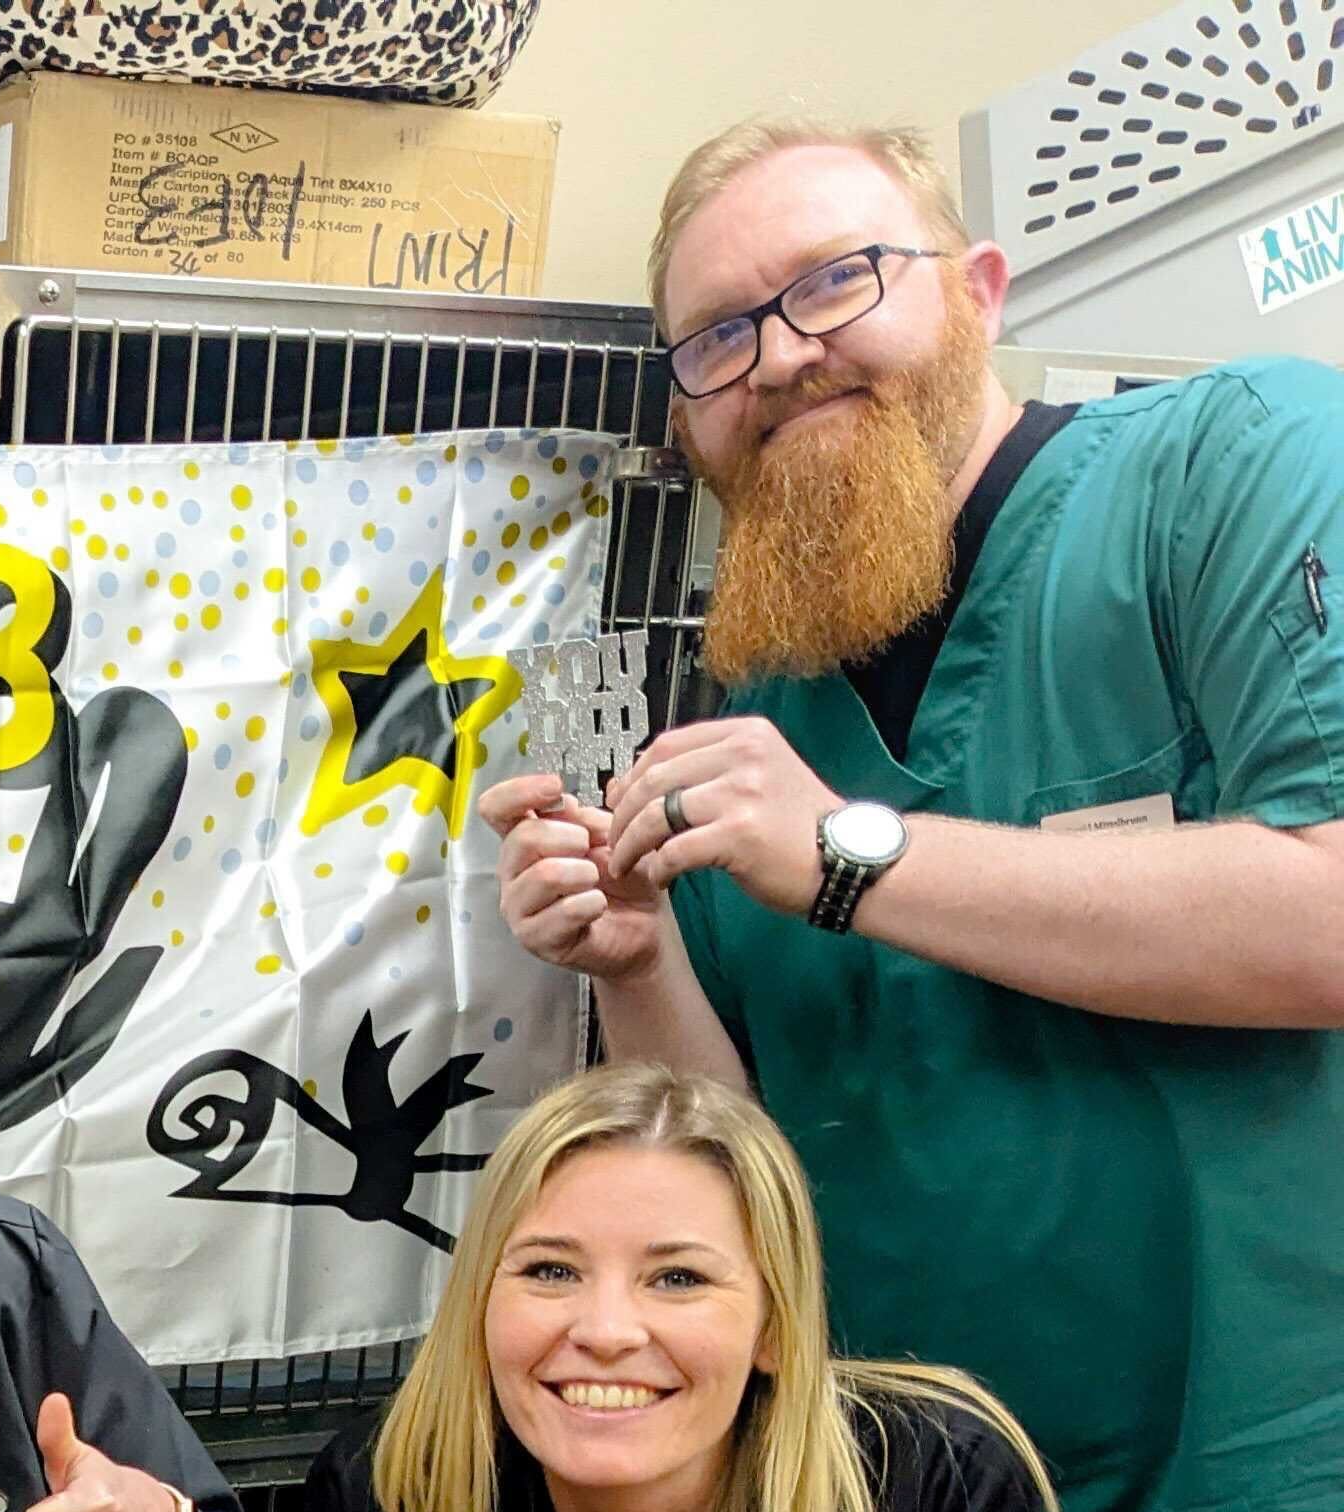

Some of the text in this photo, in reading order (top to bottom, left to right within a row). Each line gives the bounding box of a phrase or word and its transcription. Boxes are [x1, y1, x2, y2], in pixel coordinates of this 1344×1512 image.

[113, 133, 136, 145] PO
[154, 133, 198, 147] 35108
[112, 148, 145, 161] Item
[111, 162, 144, 175] Item
[309, 175, 335, 189] Tint
[163, 180, 209, 193] Carton
[362, 196, 386, 209] 250
[390, 200, 421, 212] PCS
[101, 243, 149, 257] Carton
[204, 253, 218, 264] of
[226, 251, 245, 263] 80
[506, 629, 650, 695] YOU
